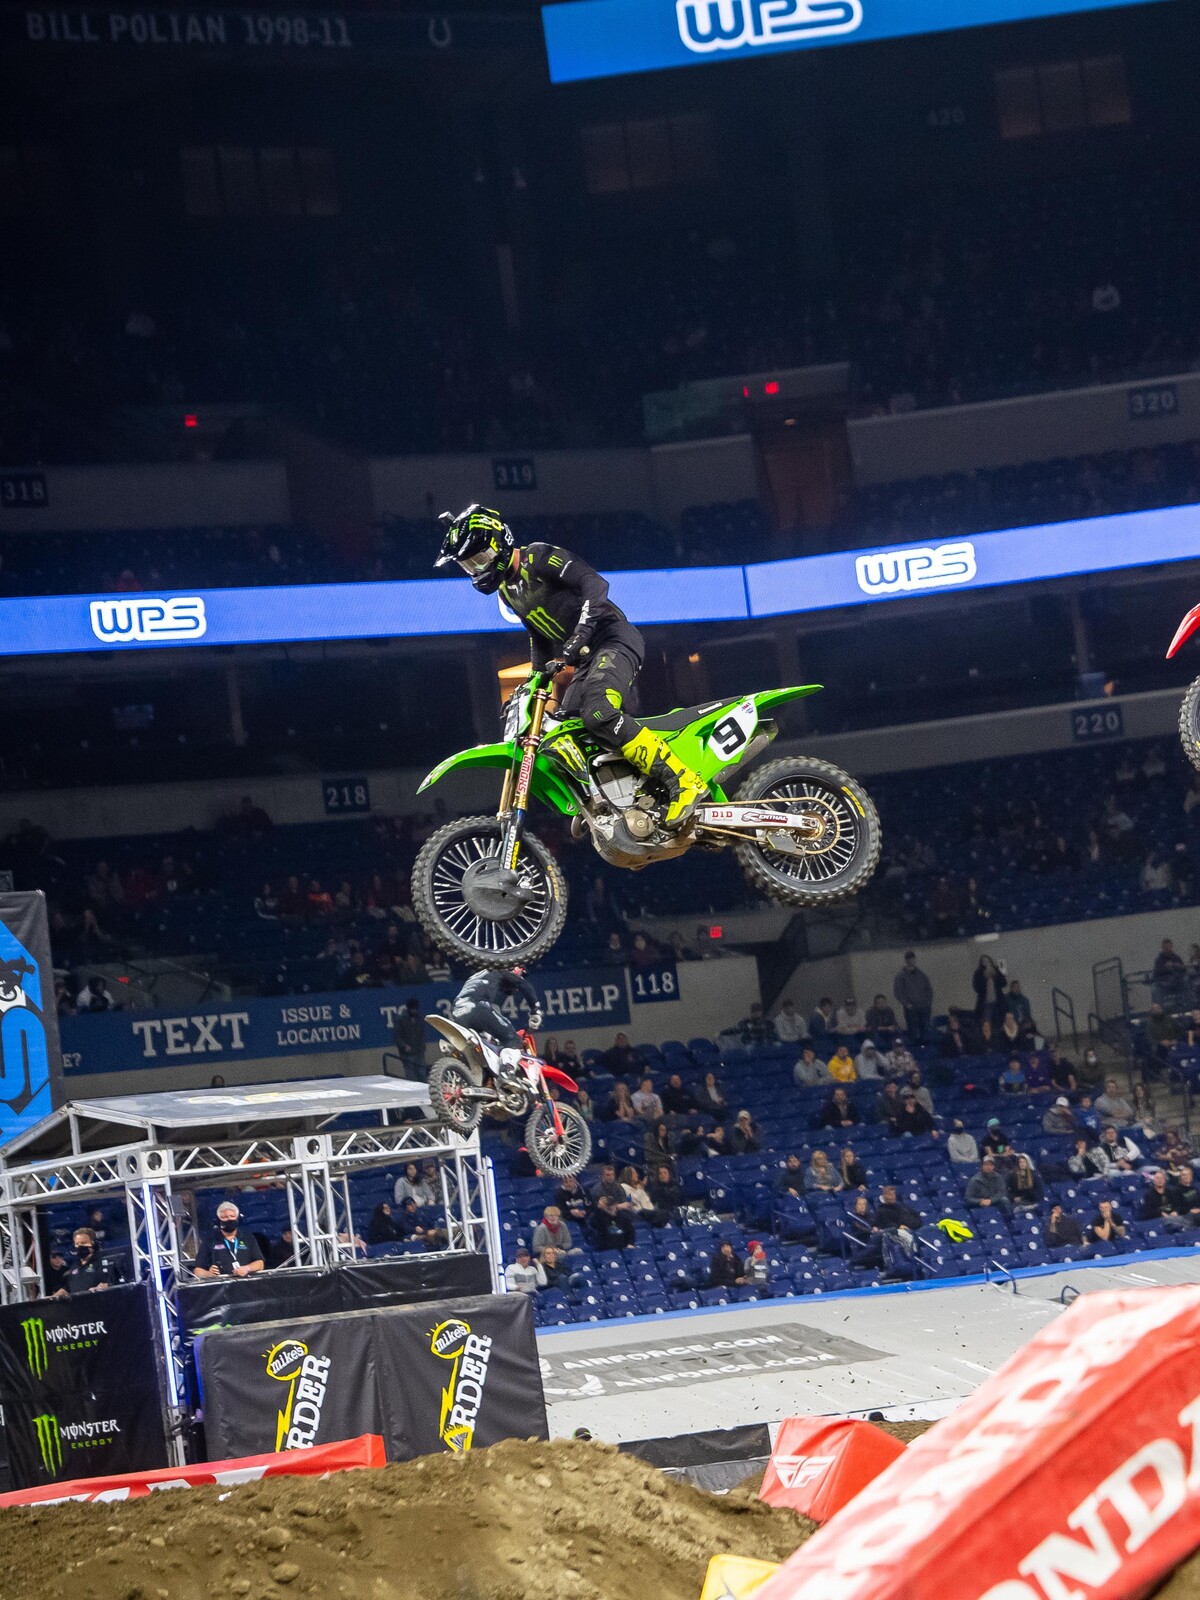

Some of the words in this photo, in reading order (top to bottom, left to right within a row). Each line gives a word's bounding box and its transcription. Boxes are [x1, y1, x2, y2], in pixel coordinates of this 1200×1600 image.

[25, 10, 99, 41] BILL
[108, 13, 226, 44] POLIAN
[676, 0, 863, 52] WPS
[496, 464, 532, 486] 319
[3, 480, 45, 502] 318
[855, 541, 977, 595] WPS
[89, 597, 207, 642] WPS
[712, 716, 747, 755] 9
[1074, 710, 1119, 736] 220
[326, 784, 367, 807] 218
[635, 971, 676, 997] 118
[132, 1012, 249, 1058] TEXT
[543, 984, 620, 1016] HELP
[281, 1005, 333, 1024] ISSUE
[339, 1003, 351, 1018] &
[276, 1023, 361, 1046] LOCATION
[45, 1320, 108, 1343] MONSTER
[56, 1339, 99, 1352] ENERGY
[562, 1335, 782, 1370] AIRFORCE.COM
[615, 1352, 836, 1388] AIRFORCE.COM
[447, 1333, 493, 1440] RDER
[285, 1354, 331, 1451] RDER
[60, 1419, 121, 1440] MONSTER
[70, 1437, 113, 1449] ENERGY
